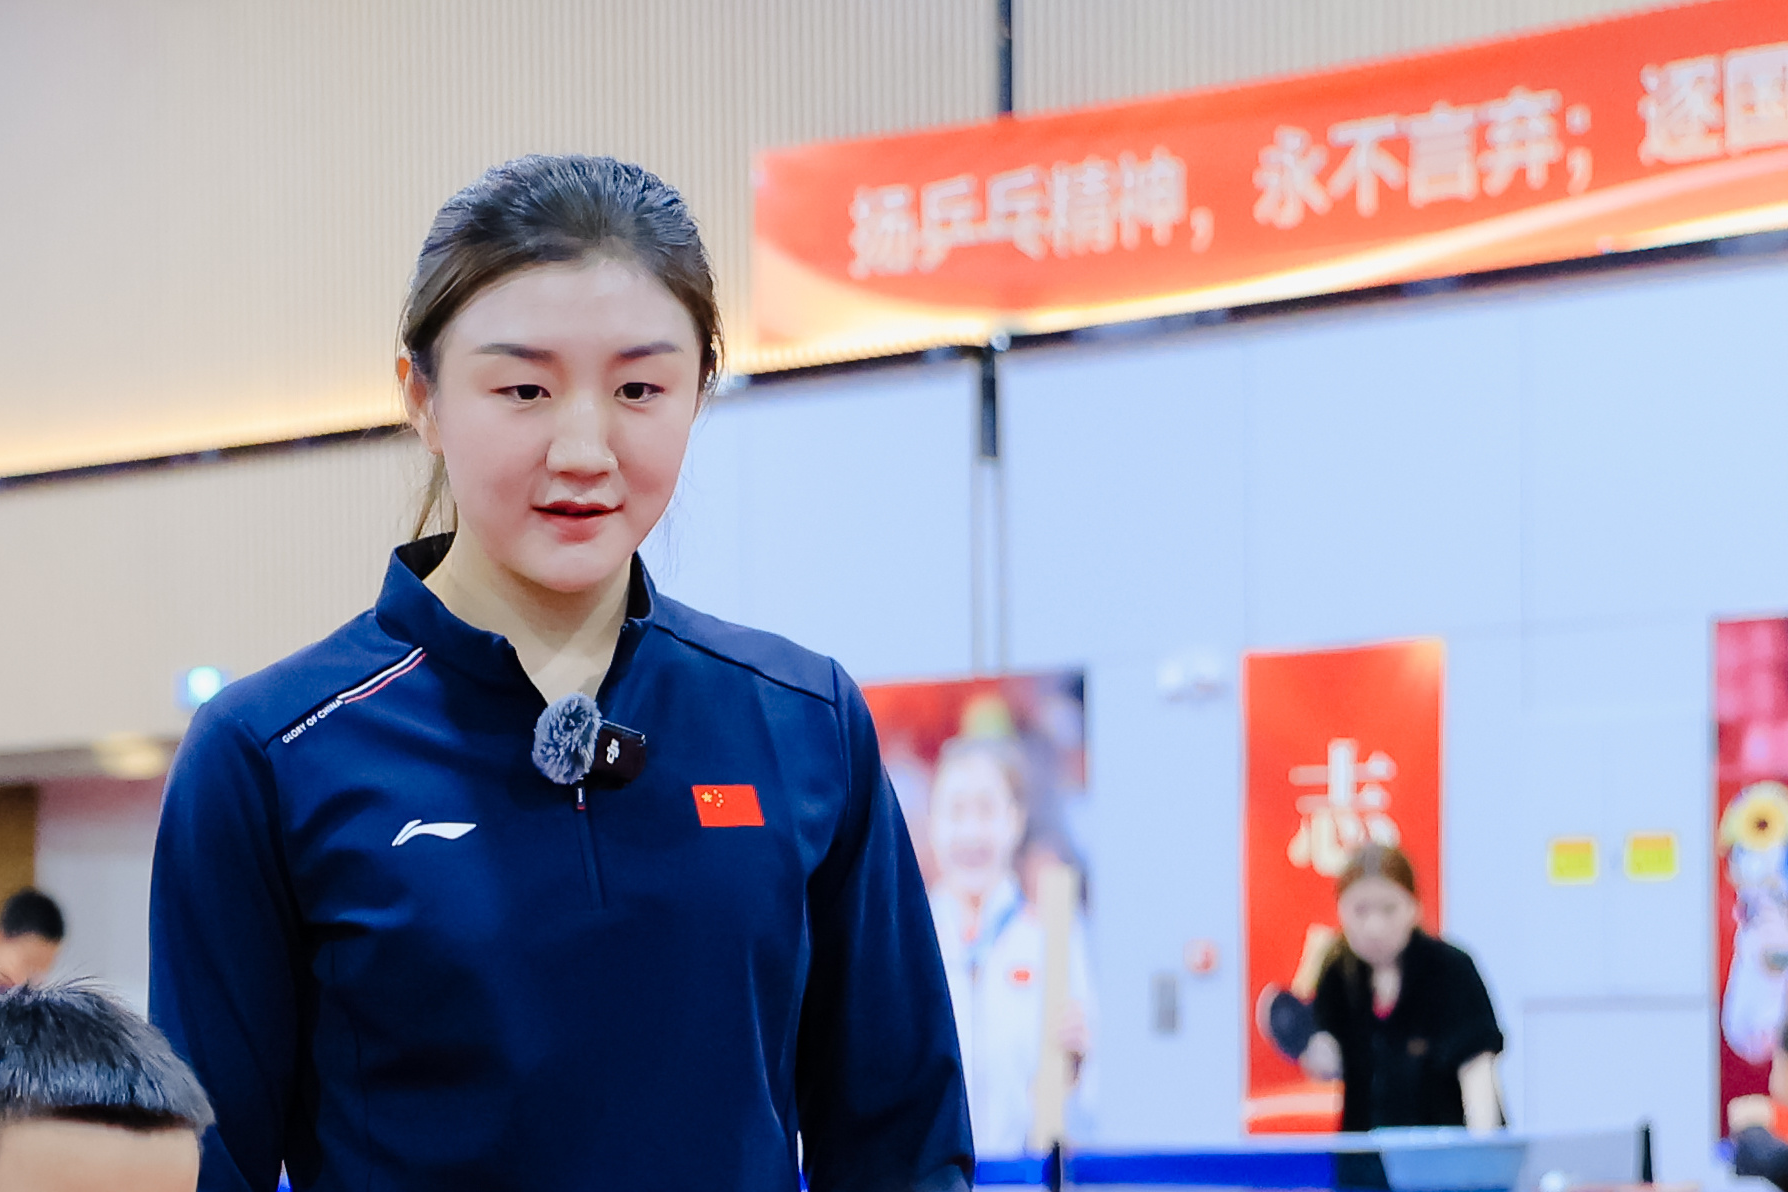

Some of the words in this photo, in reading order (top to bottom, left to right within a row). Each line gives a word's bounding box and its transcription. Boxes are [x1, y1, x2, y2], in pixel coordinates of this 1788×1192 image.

[282, 722, 307, 744] GLORY
[306, 714, 318, 727] OF
[317, 699, 344, 719] CHINA
